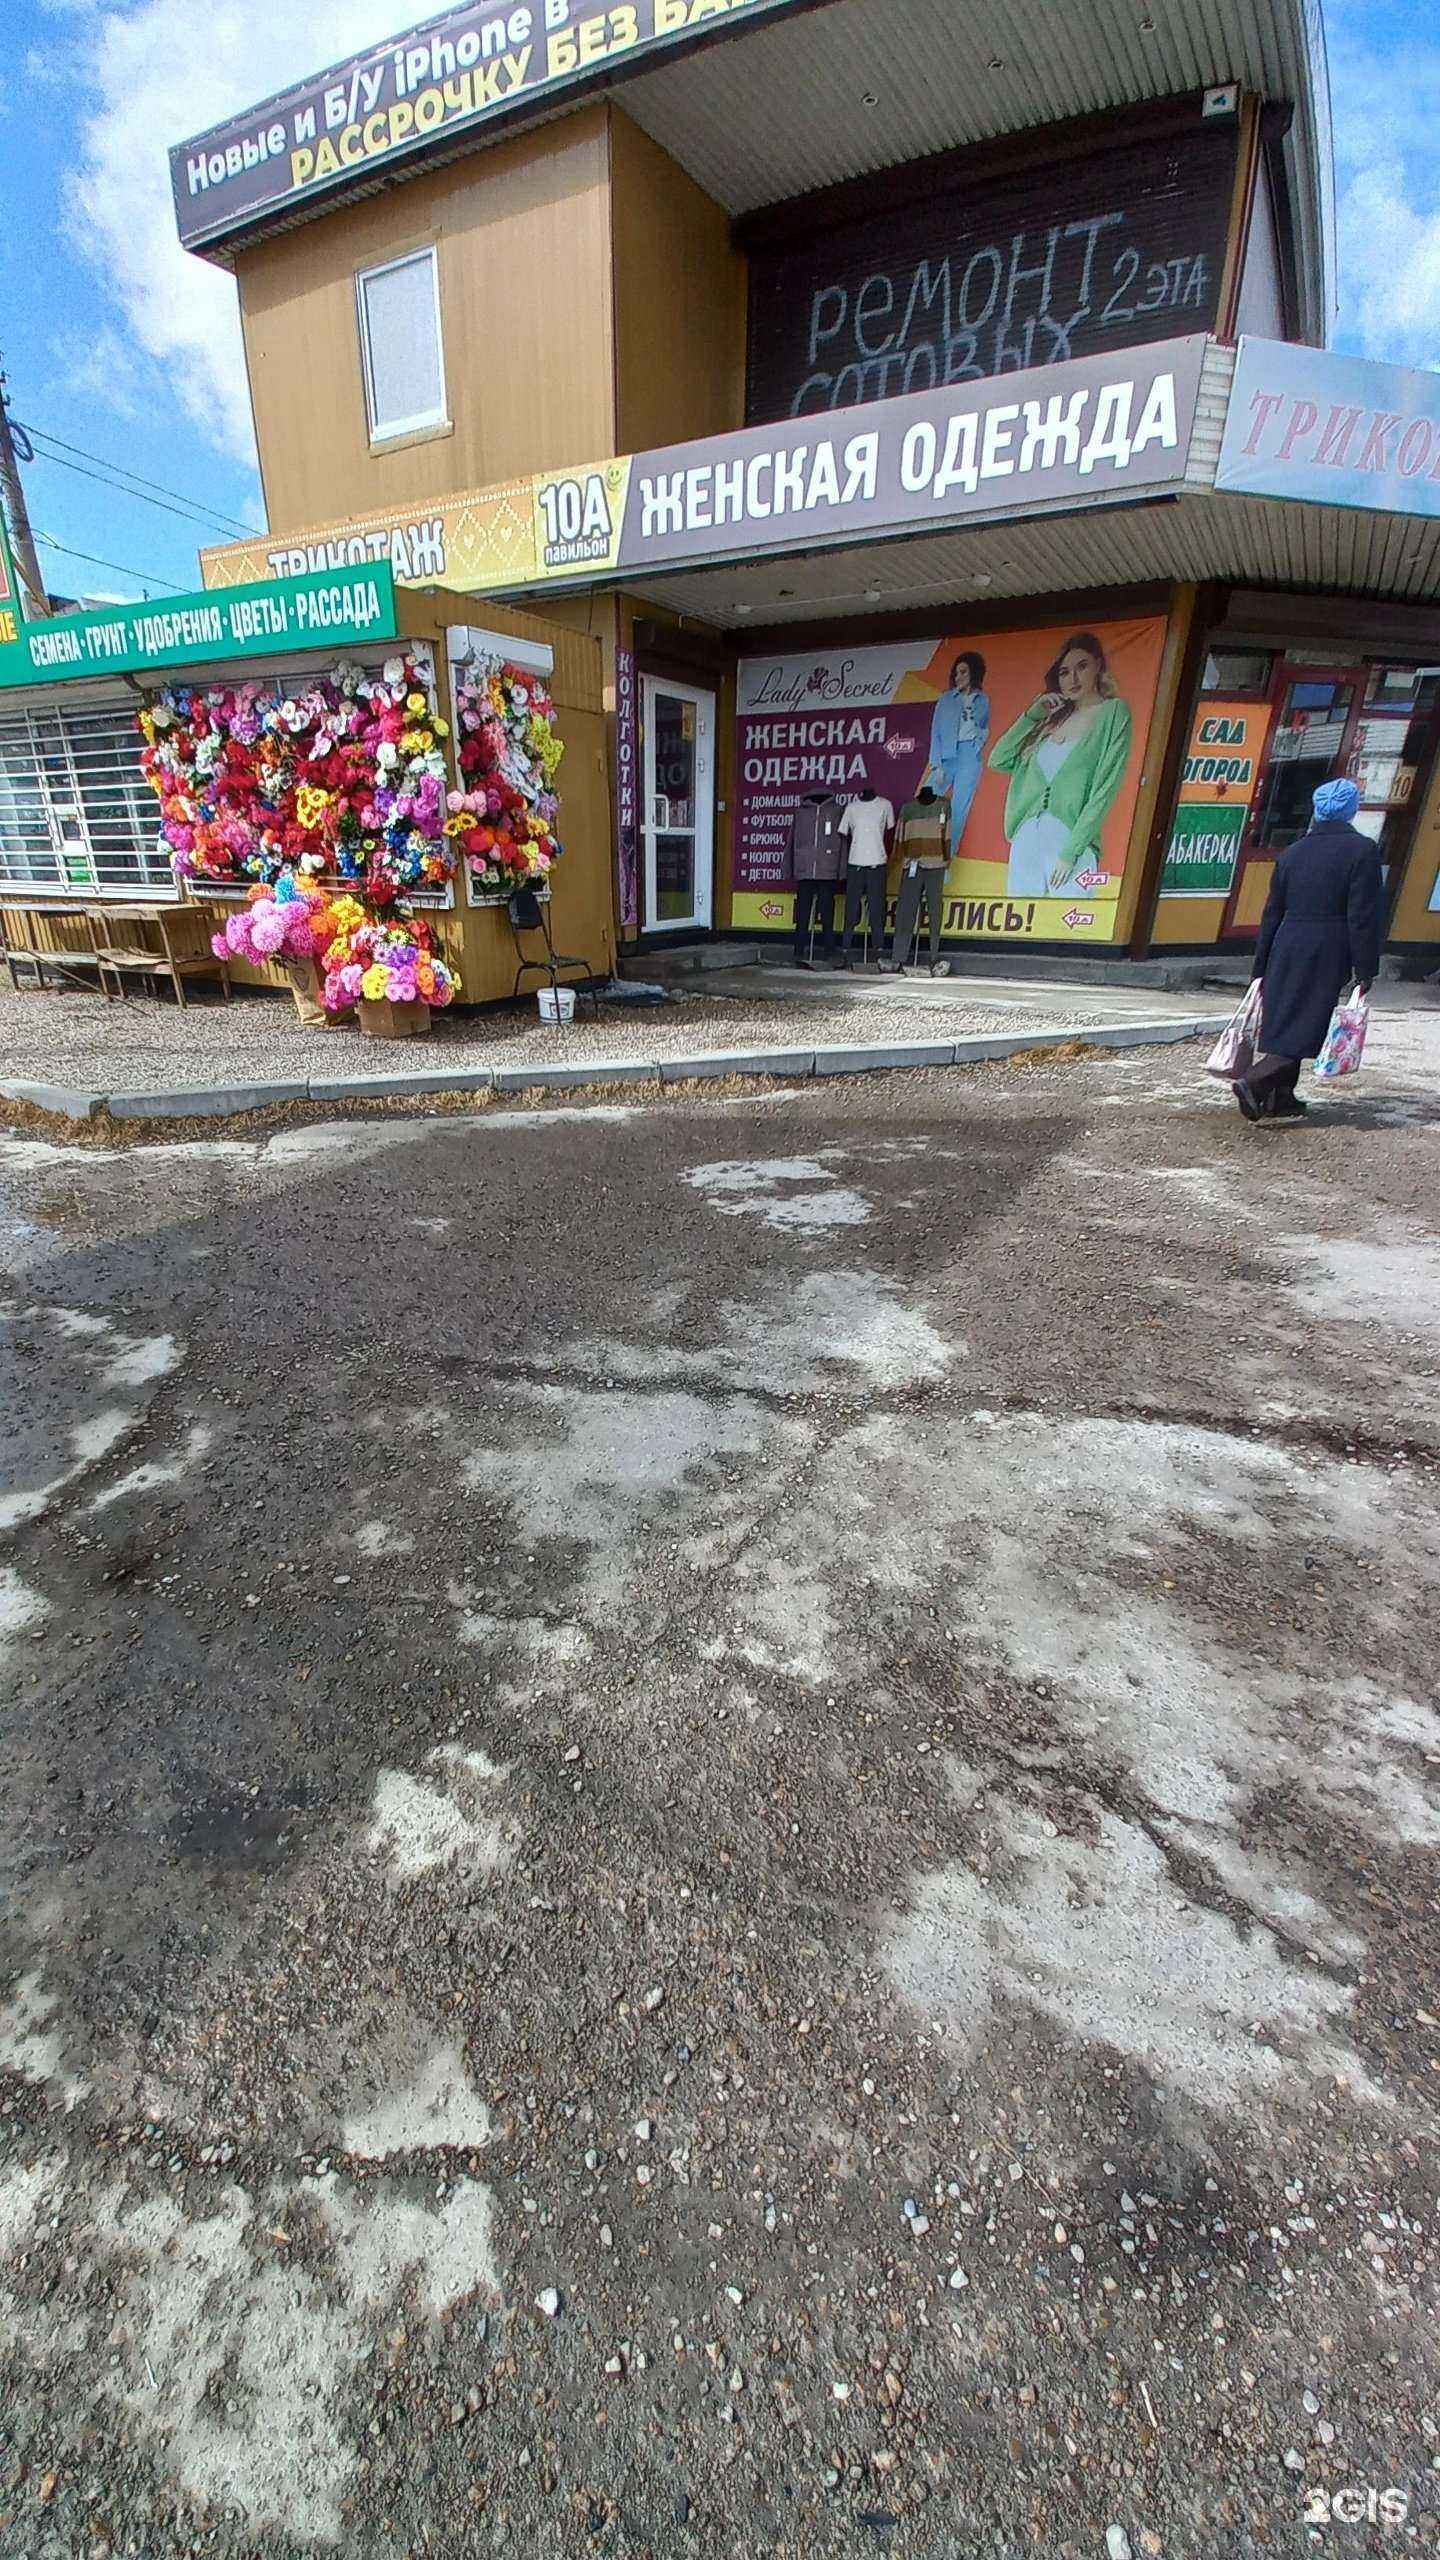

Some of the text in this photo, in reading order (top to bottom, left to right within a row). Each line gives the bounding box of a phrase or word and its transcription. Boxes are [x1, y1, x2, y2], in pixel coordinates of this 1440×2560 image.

[187, 123, 286, 195] Новые
[394, 11, 531, 98] iPhone
[291, 44, 533, 187] РАССРОЧКУ
[547, 5, 638, 77] БЕЗ
[1101, 247, 1140, 324] 2
[640, 372, 1178, 538] ЖЕНСКАЯ ОДЕЖДА
[1240, 388, 1440, 481] ТРИКО
[539, 473, 613, 544] 10А
[268, 519, 446, 582] ТРИКОТАЖ
[545, 537, 608, 565] павильон
[29, 580, 381, 667] СЕМЕНА ГРУНТ УДОБРЕНИЯ ЦВЕТЫ РАССАДА
[747, 660, 897, 712] Lady Secret
[618, 652, 633, 828] КОЛГОТКИ
[745, 716, 887, 750] ЖЕНСКАЯ
[1198, 716, 1246, 746] САД
[743, 753, 868, 787] ОДЕЖДА
[1393, 775, 1411, 798] 10
[751, 794, 801, 809] ДОМАШН
[749, 851, 784, 863] КОЛГОТ
[1166, 832, 1239, 865] АБАКЕРКА
